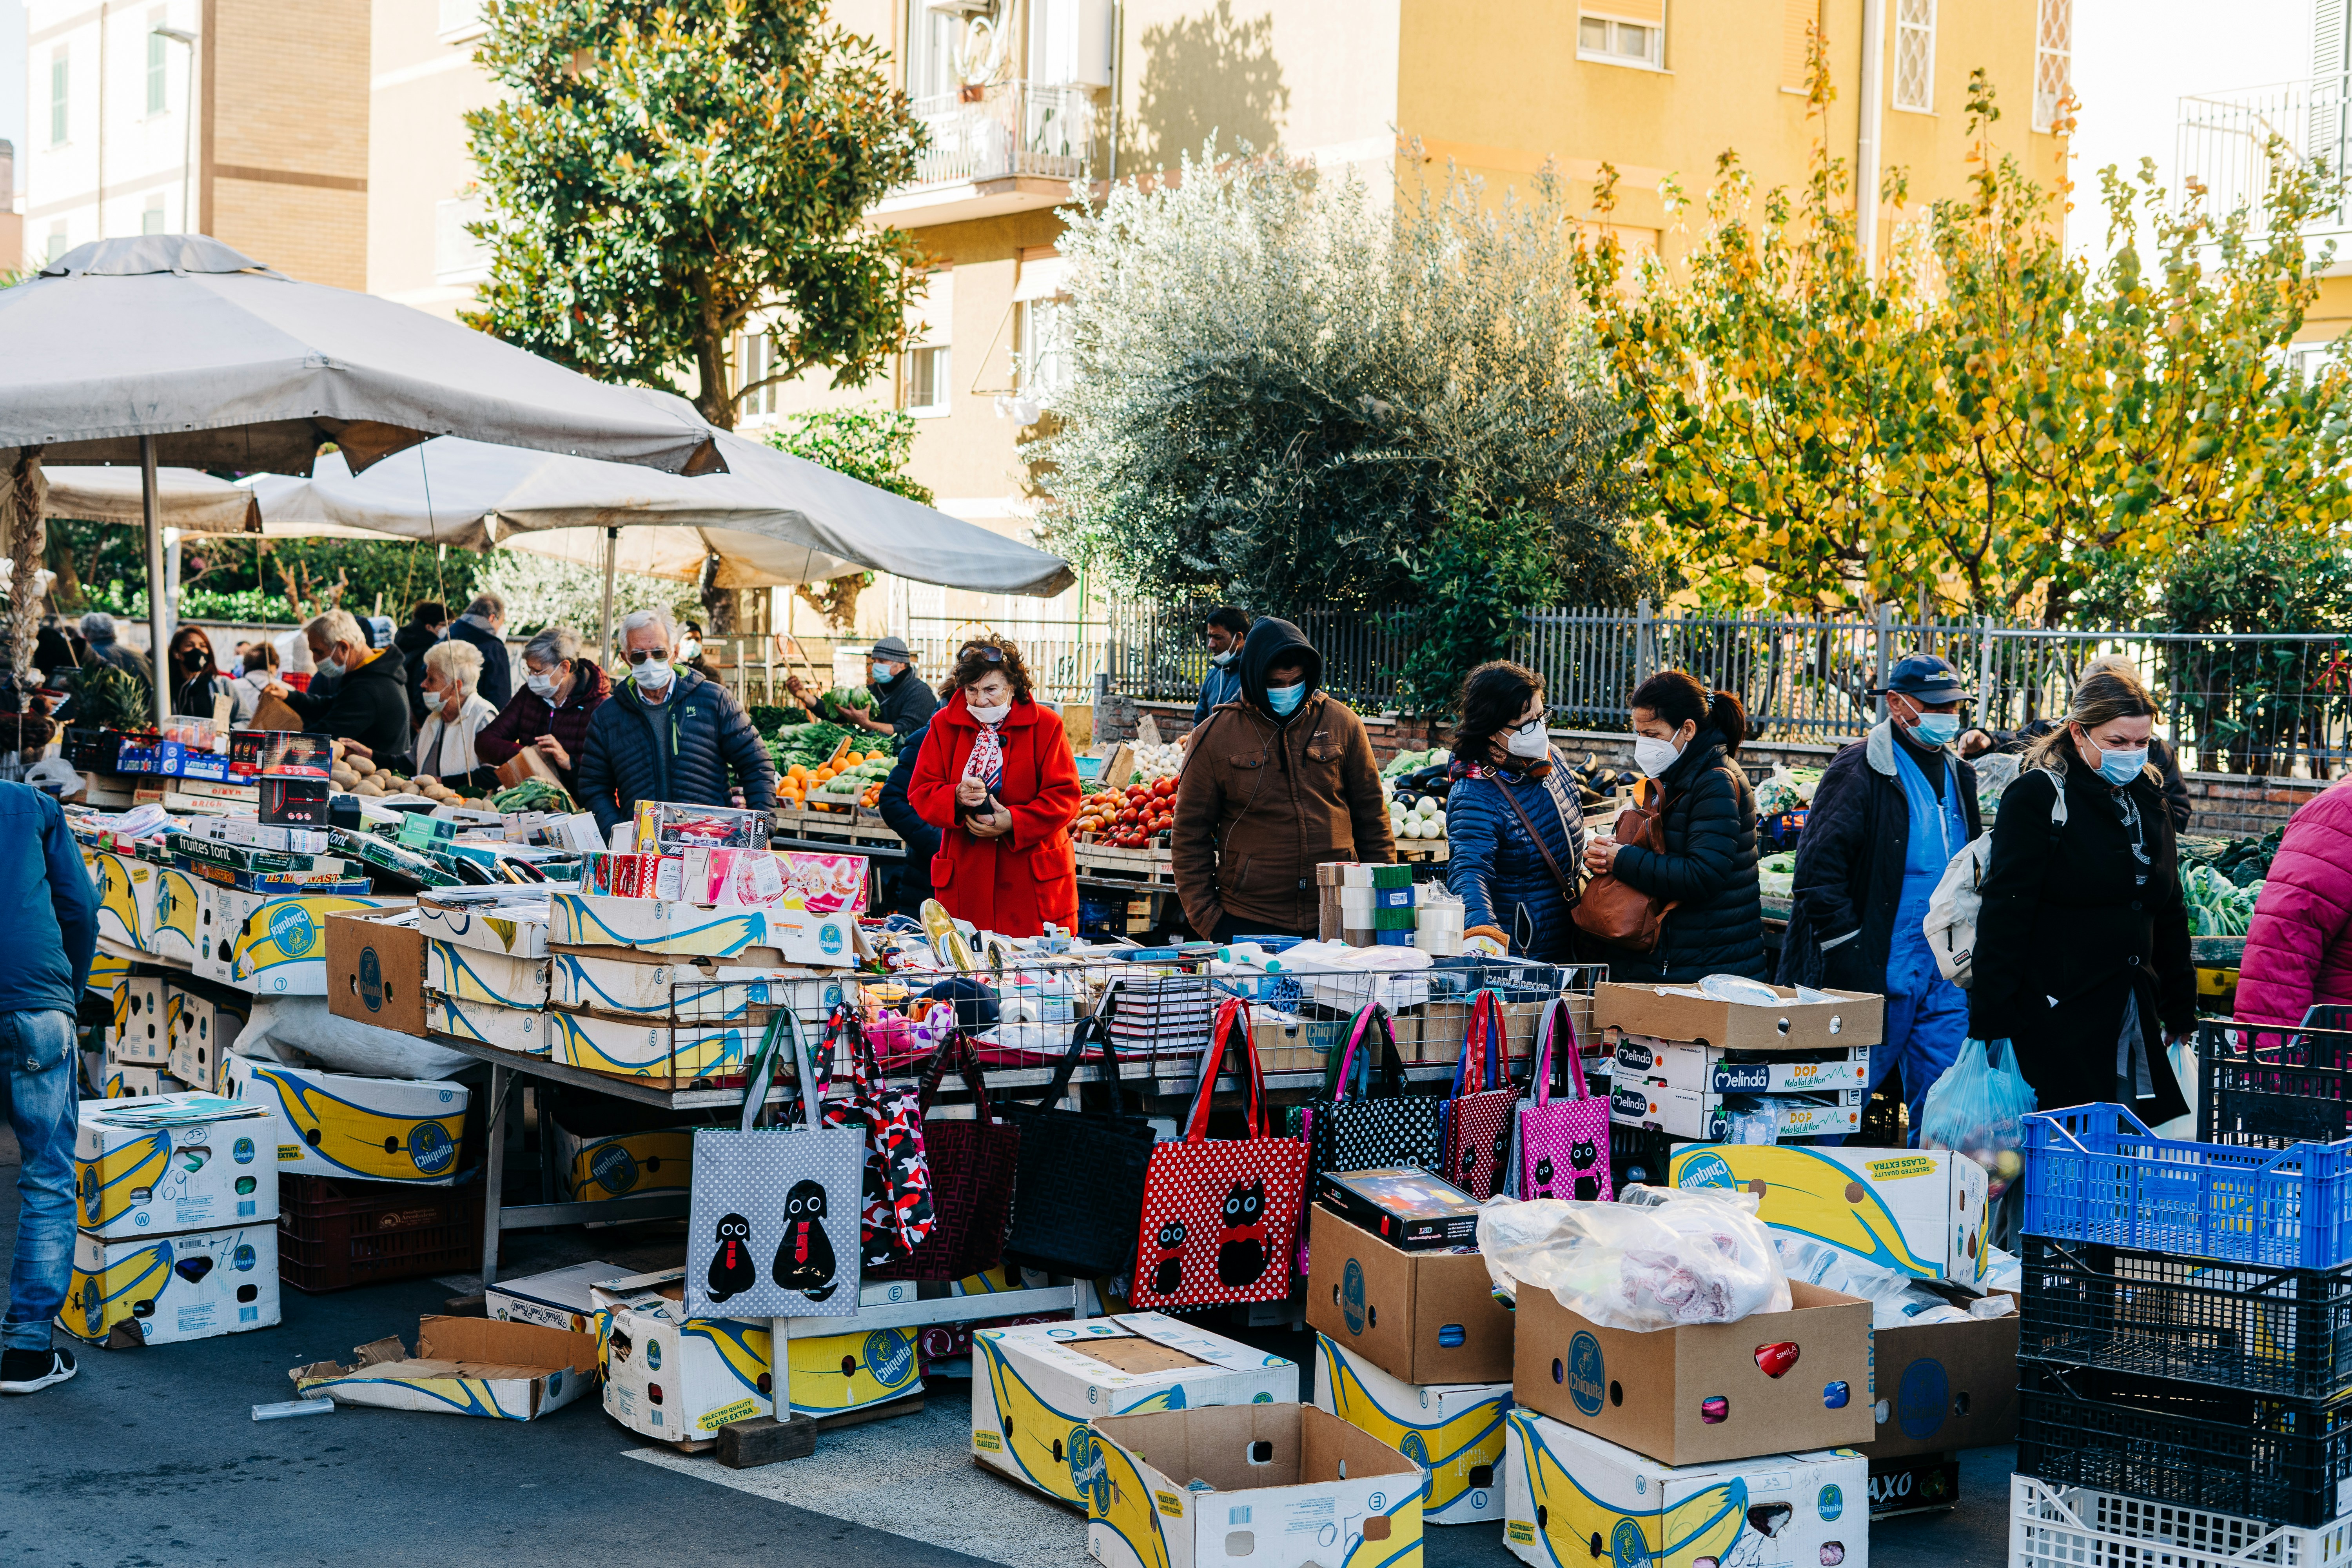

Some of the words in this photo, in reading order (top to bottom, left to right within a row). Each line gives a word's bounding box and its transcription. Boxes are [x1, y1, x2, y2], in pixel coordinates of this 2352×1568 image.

[328, 829, 349, 847] font
[179, 833, 209, 855] fruites
[211, 841, 231, 861] font
[191, 860, 198, 872] IL
[855, 867, 866, 891] Dancing
[270, 909, 309, 938] Chiquita
[820, 940, 842, 950] Chiquita
[1955, 953, 1968, 963] invicta
[361, 982, 382, 1000] Chiquita
[1485, 975, 1517, 988] CANDLE
[1519, 981, 1550, 993] DECOR
[1618, 1048, 1651, 1064] Melinda
[1715, 1070, 1766, 1088] Melinda
[1784, 1078, 1798, 1087] Mela
[1797, 1077, 1806, 1086] Val
[1806, 1076, 1812, 1085] di
[1812, 1075, 1825, 1083] Non
[1612, 1095, 1645, 1110] Melinda
[189, 1130, 203, 1139] 37
[1780, 1125, 1793, 1134] Mela
[1793, 1124, 1802, 1133] Val
[234, 1151, 254, 1160] Chiquita
[415, 1143, 453, 1168] Chiquita
[592, 1149, 627, 1177] Chiquita
[1902, 1158, 1927, 1167] CLASS
[1873, 1161, 1900, 1171] EXTRA
[1902, 1165, 1930, 1174] SELECTED
[1679, 1159, 1728, 1189] Chiquita
[161, 1169, 188, 1201] 69
[1331, 1188, 1341, 1199] LED
[85, 1191, 101, 1216] Chiquita
[235, 1258, 255, 1267] Chiquita
[86, 1304, 103, 1326] Chiquita
[1343, 1298, 1364, 1321] Chiquita
[542, 1311, 567, 1329] Florida
[647, 1353, 661, 1365] Chiquita
[875, 1343, 911, 1383] Chiquita
[1570, 1372, 1603, 1401] Chiquita
[702, 1410, 729, 1422] SELECTED
[730, 1400, 752, 1415] QUALITY
[706, 1417, 728, 1430] CLASS
[730, 1407, 754, 1424] EXTRA
[987, 1442, 1000, 1450] EXTRA
[1158, 1494, 1168, 1503] EXTRA
[1169, 1497, 1179, 1506] CLASS
[1159, 1504, 1169, 1513] QUALITY
[1169, 1506, 1181, 1515] SELECTED
[1818, 1503, 1842, 1514] Chiquita
[1510, 1530, 1521, 1539] CLASS
[1521, 1532, 1533, 1542] EXTRA
